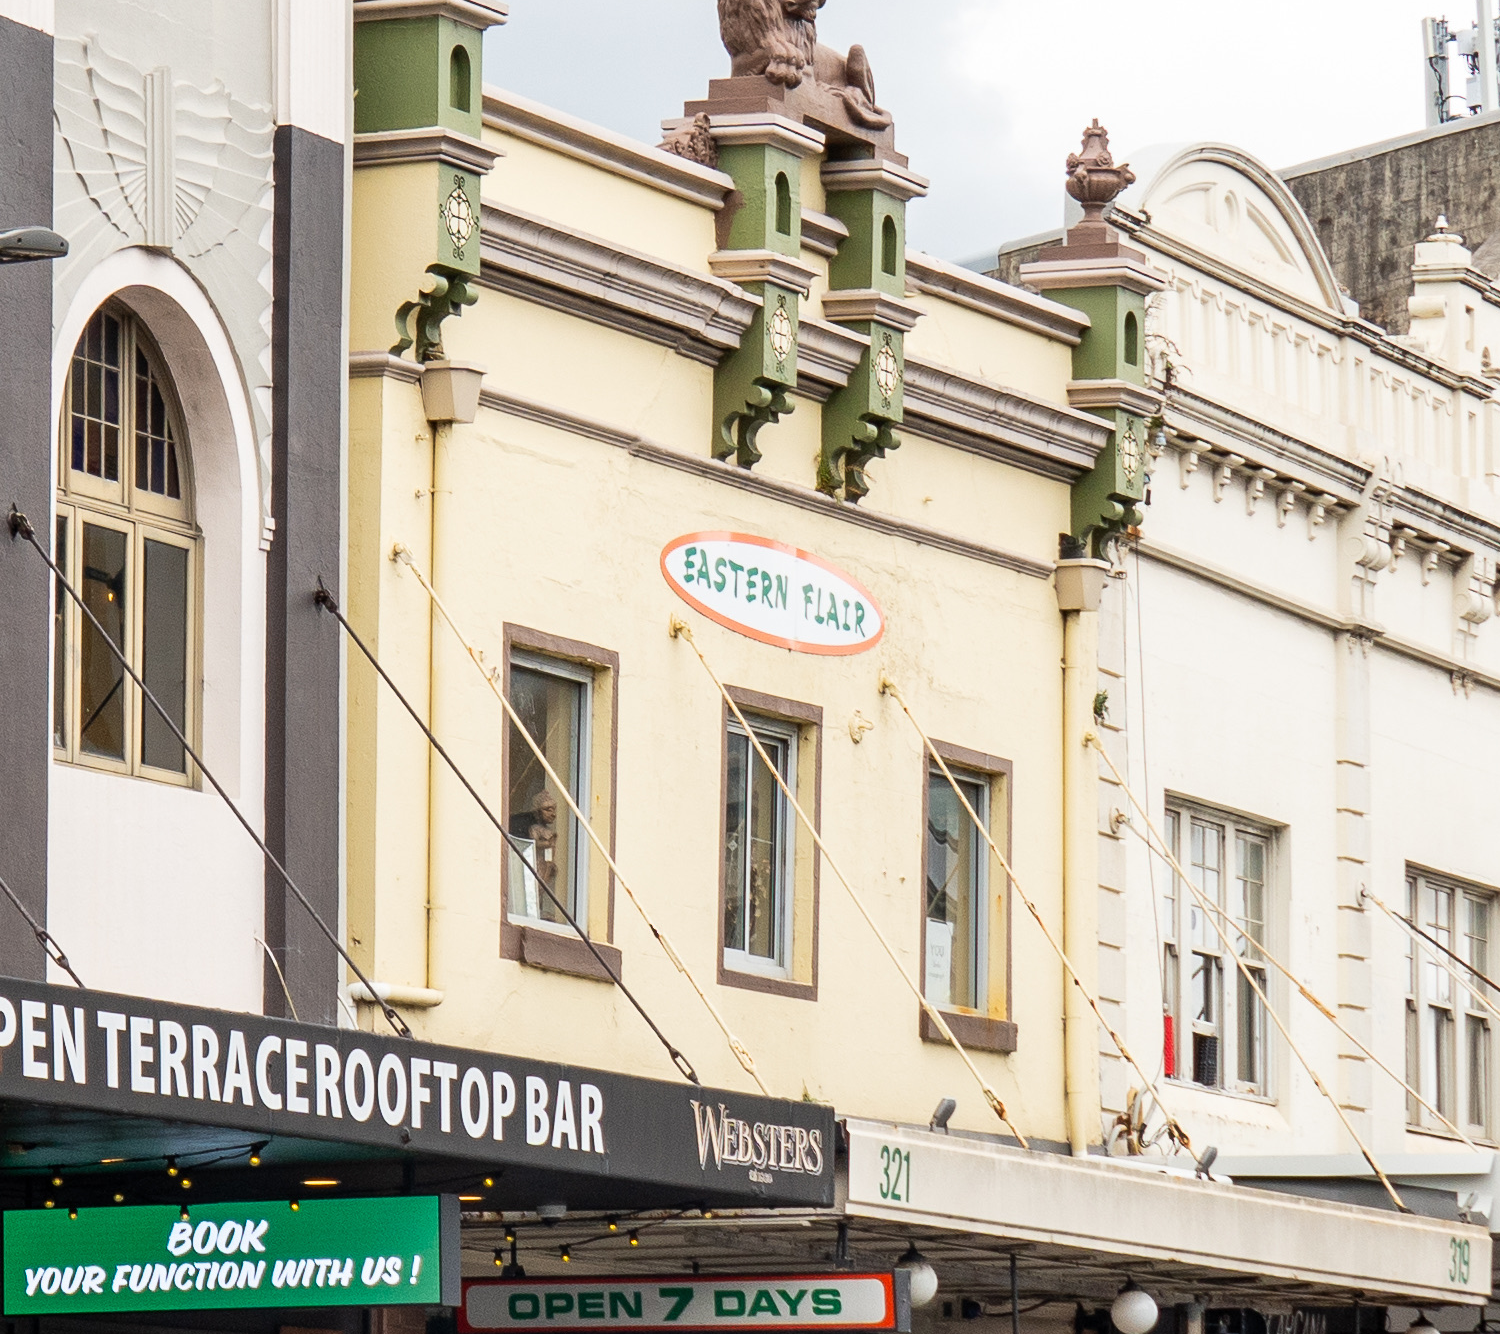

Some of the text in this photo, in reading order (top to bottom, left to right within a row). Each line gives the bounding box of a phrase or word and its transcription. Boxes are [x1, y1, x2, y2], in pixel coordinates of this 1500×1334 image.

[683, 546, 866, 638] EASTERN FLAIR
[97, 1010, 310, 1115] TERRACE
[315, 1042, 605, 1153] ROOFTOP BAR
[690, 1099, 824, 1177] WEBSTERS
[879, 1144, 911, 1204] 321
[166, 1218, 269, 1257] BOOK
[1449, 1236, 1471, 1285] 319
[24, 1264, 106, 1297] YOUR
[112, 1259, 265, 1293] FUNCTION
[271, 1256, 355, 1289] WITH
[360, 1256, 402, 1286] US
[507, 1287, 844, 1323] OPEN 7 DAYS
